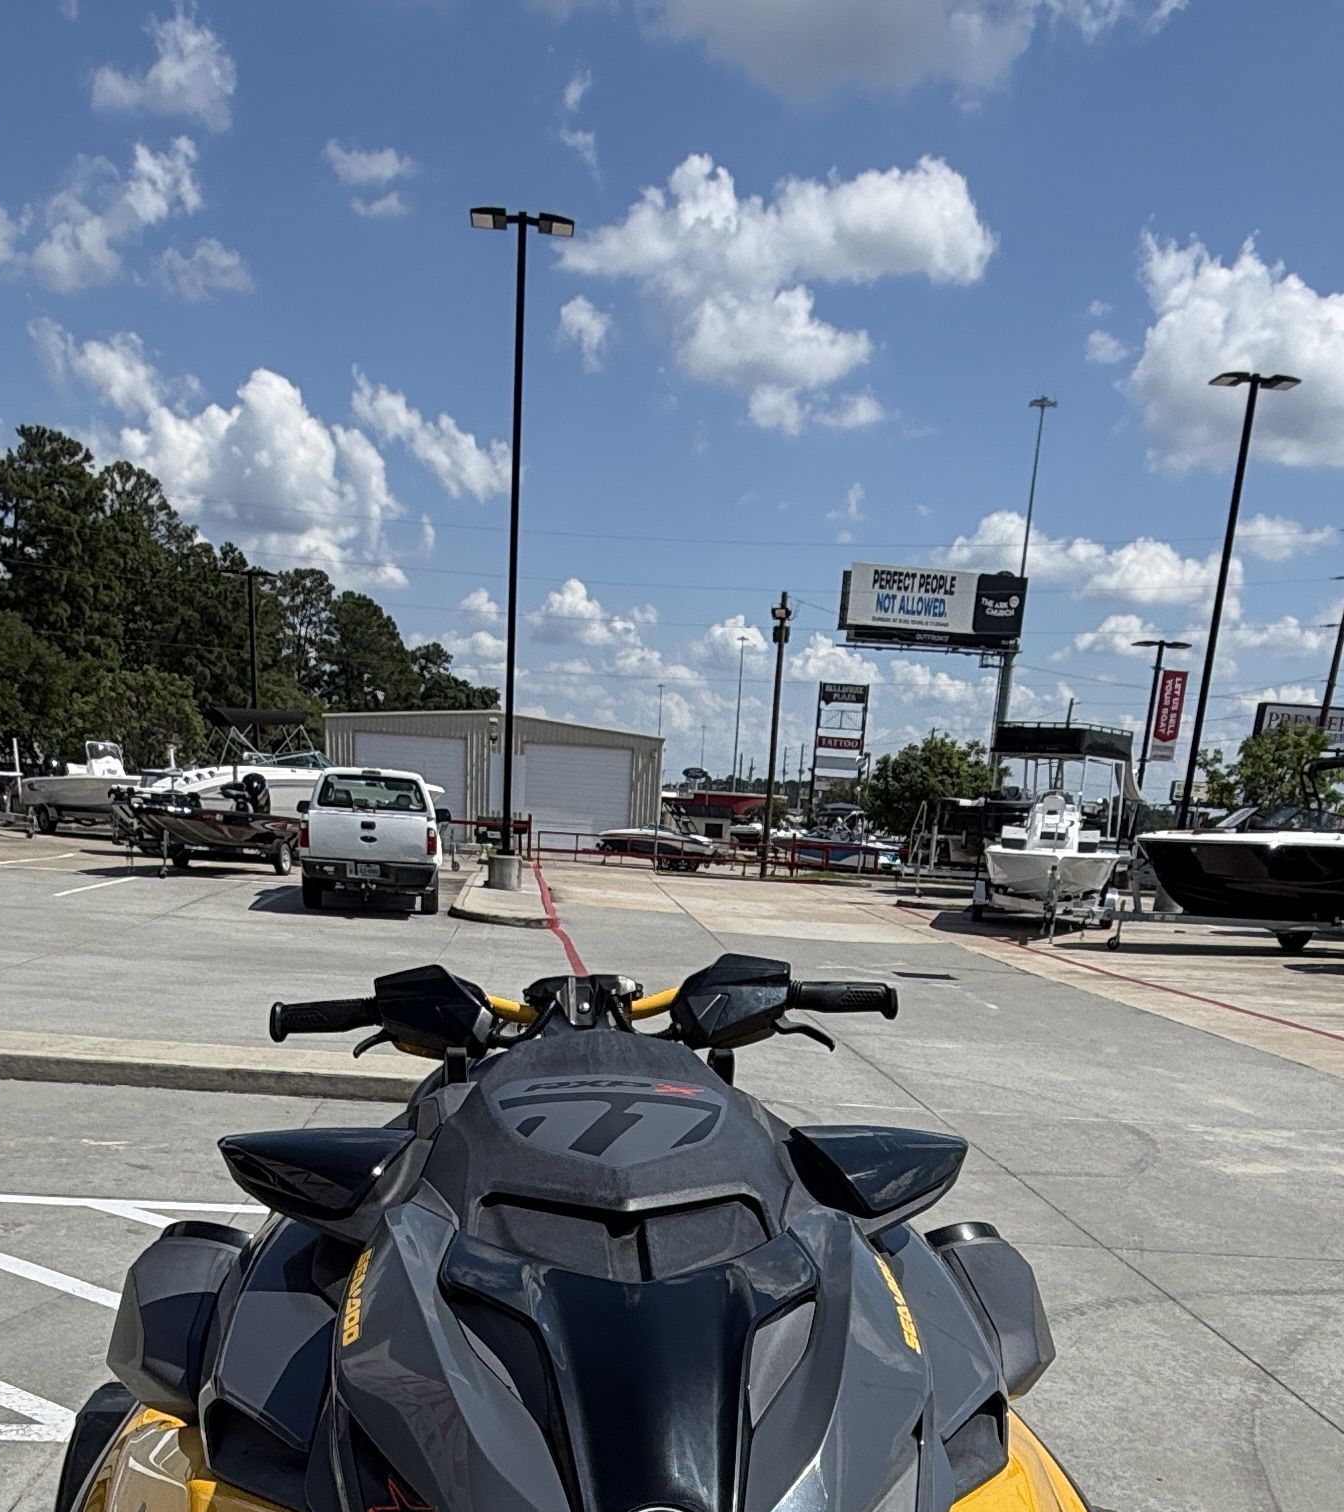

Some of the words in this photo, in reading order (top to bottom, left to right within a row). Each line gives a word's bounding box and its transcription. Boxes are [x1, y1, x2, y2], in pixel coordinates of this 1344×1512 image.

[872, 569, 917, 593] PERFECT
[918, 574, 957, 596] PEOPLE
[875, 593, 897, 614] NOT
[898, 595, 947, 618] ALLOWED.
[985, 607, 1015, 617] CHURCH
[1163, 678, 1173, 706] YOUR
[1174, 677, 1183, 697] LET
[1171, 697, 1180, 711] US
[1158, 707, 1169, 734] BOAT
[1166, 712, 1177, 736] SELL
[821, 737, 859, 748] TATTOO
